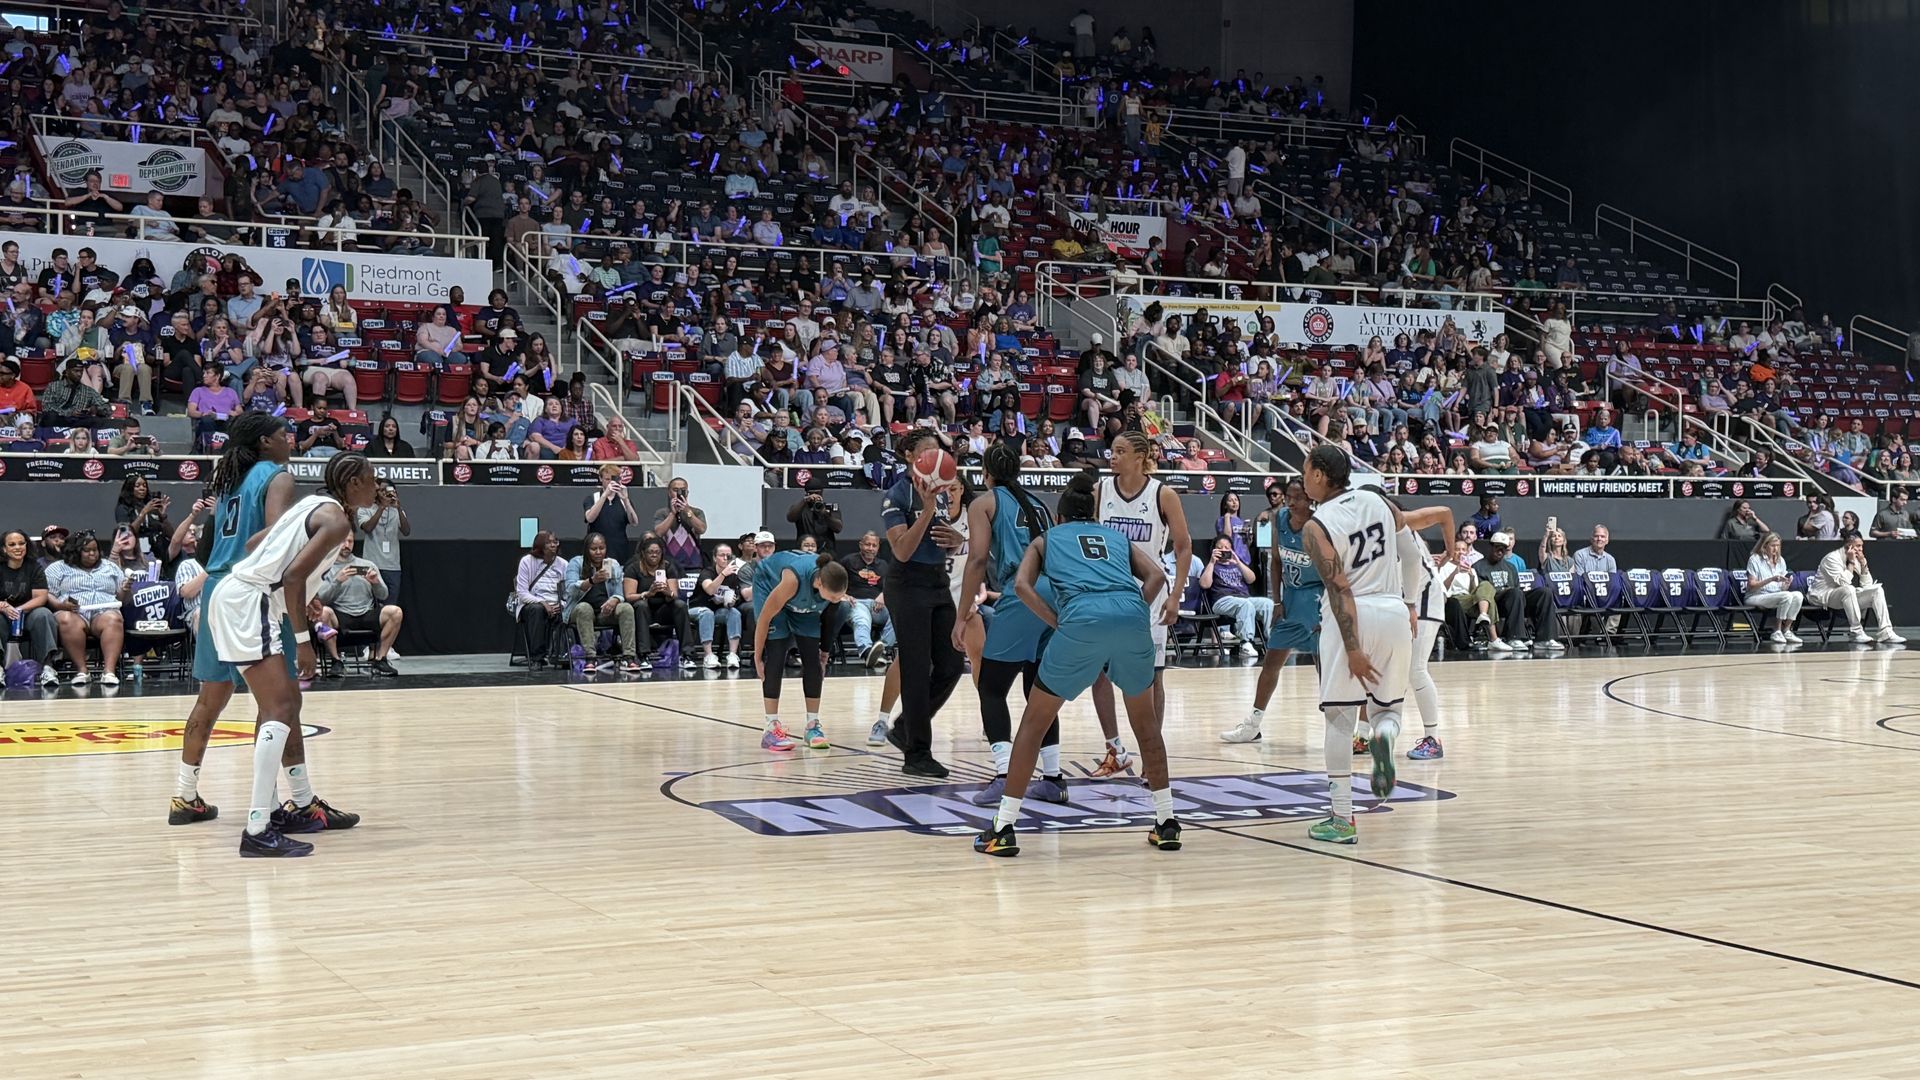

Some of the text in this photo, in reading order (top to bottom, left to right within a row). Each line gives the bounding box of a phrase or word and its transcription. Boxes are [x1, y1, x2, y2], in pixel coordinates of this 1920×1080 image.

[52, 155, 102, 171] PENDAWORTHY
[140, 163, 196, 178] DEPENDAWORTHY
[1074, 218, 1140, 234] ONE HOUR
[274, 236, 286, 247] 26
[362, 264, 441, 282] Piedmont
[362, 280, 448, 297] Natural Ga
[1304, 308, 1332, 323] CHARLOTTE
[1360, 312, 1455, 327] AUTOHAU
[1304, 328, 1332, 342] CHECKERS
[1360, 326, 1394, 336] LAKE
[355, 361, 378, 369] CROWN
[26, 460, 64, 470] FREEMORE
[124, 462, 160, 471] FREEMORE
[287, 464, 321, 477] NEW
[390, 467, 432, 480] MEET.
[1018, 476, 1072, 486] NEW FRIEN
[1543, 482, 1664, 493] WHERE NEW FRIENDS MEET.
[221, 494, 242, 539] 0
[1077, 534, 1110, 561] 6
[1349, 522, 1386, 569] 23
[1278, 546, 1312, 566] WAVES
[1557, 582, 1570, 595] 26
[1595, 583, 1607, 596] 26
[1635, 582, 1647, 595] 26
[1670, 583, 1681, 596] 26
[1705, 582, 1716, 595] 26
[135, 586, 168, 606] CROWN
[145, 602, 166, 620] 26
[929, 804, 1369, 834] CHARLOTE
